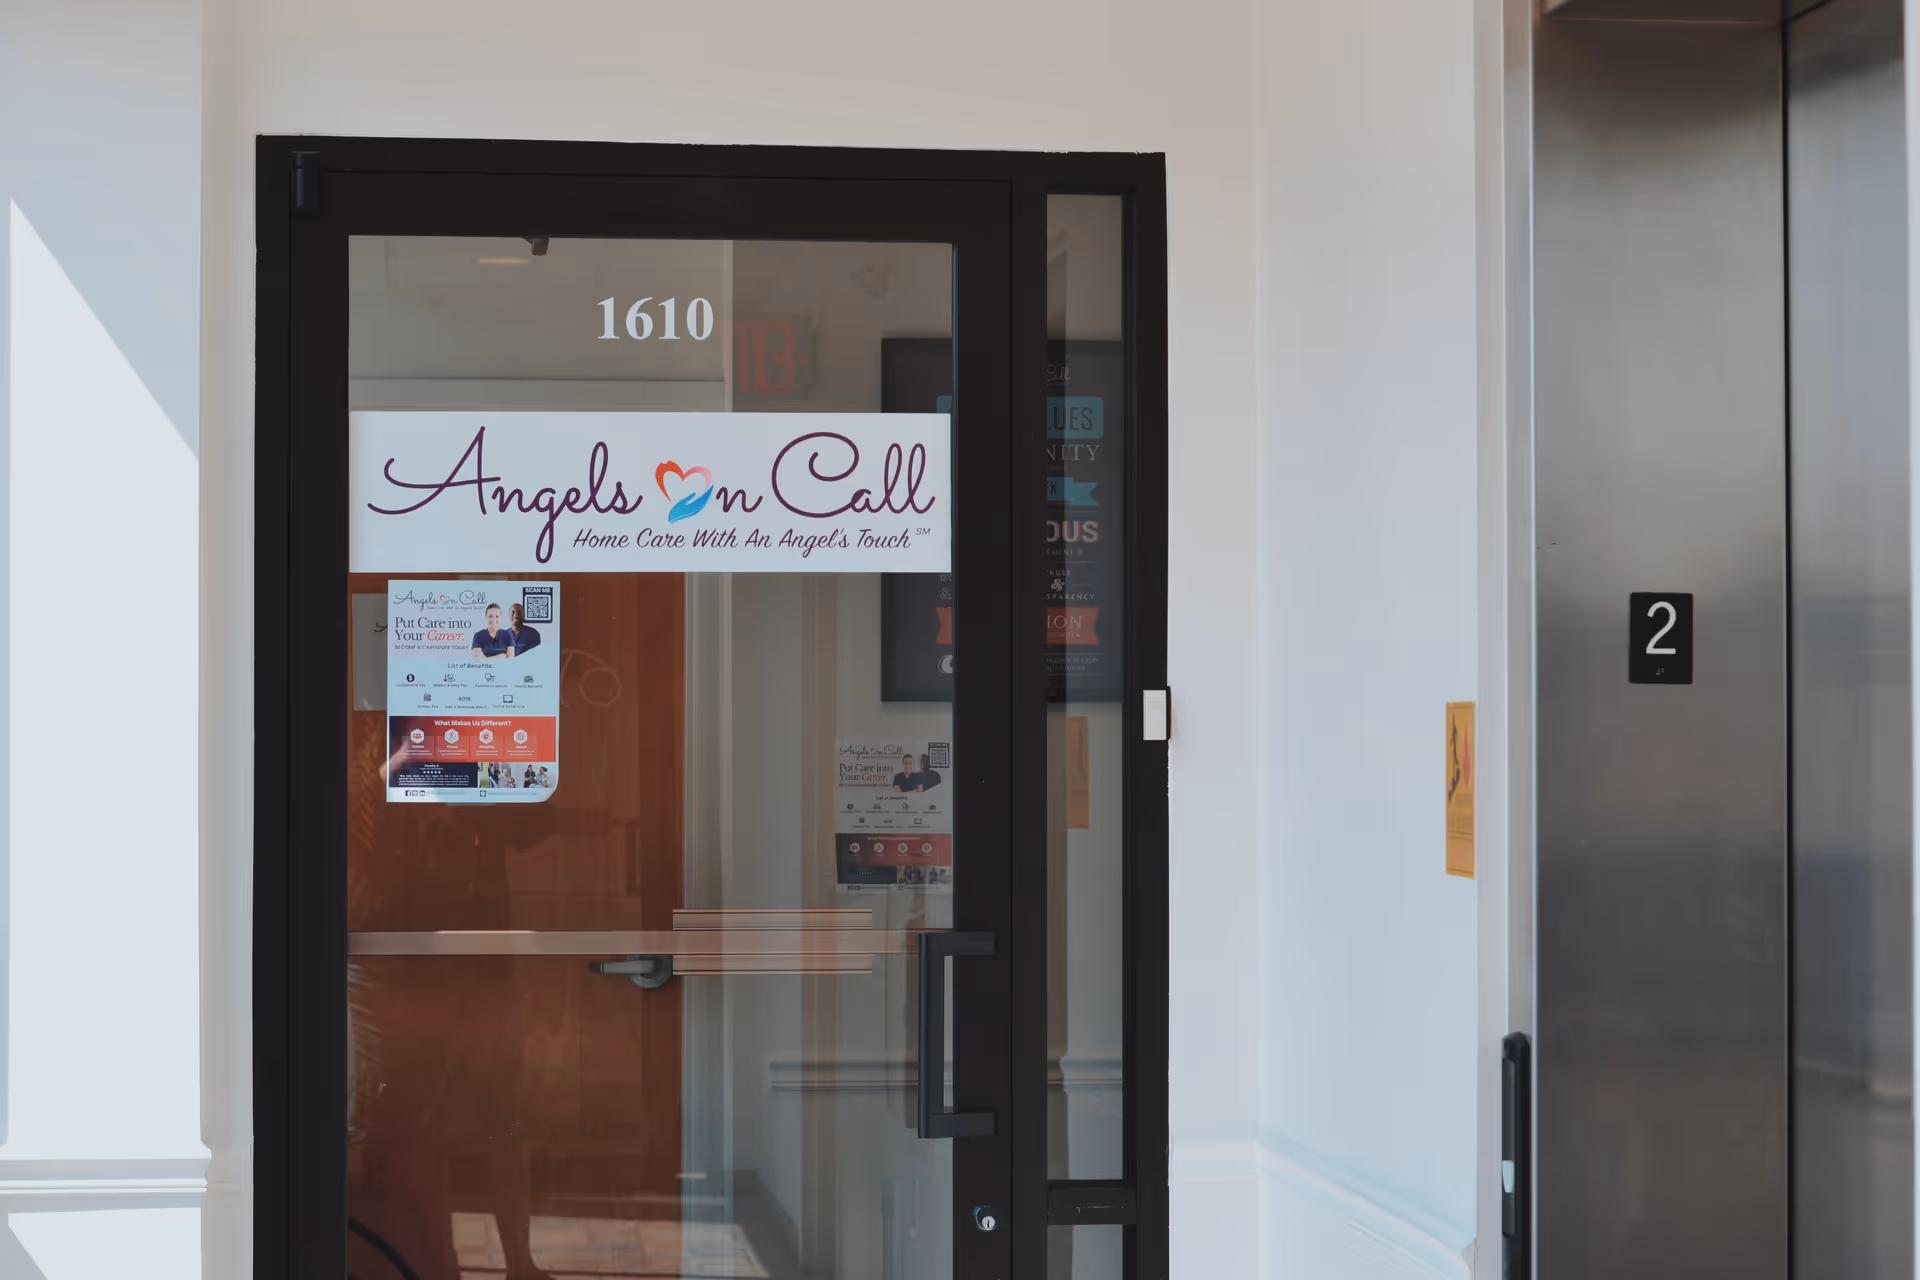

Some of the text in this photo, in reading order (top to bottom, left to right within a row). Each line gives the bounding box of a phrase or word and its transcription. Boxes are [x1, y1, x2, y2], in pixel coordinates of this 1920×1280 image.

[597, 297, 714, 340] 1610
[367, 426, 643, 563] Angels
[771, 432, 935, 518] Call
[573, 527, 931, 558] Home Care With An Angel's Touch SM
[1051, 578, 1065, 591] &
[393, 590, 439, 612] Angels
[459, 590, 487, 605] Call
[395, 617, 416, 629] Put
[418, 617, 445, 629] Care
[448, 616, 472, 629] into
[1646, 601, 1677, 655] 2
[395, 629, 465, 642] Your Career.
[840, 763, 893, 772] Put Care into
[840, 773, 860, 781] Your
